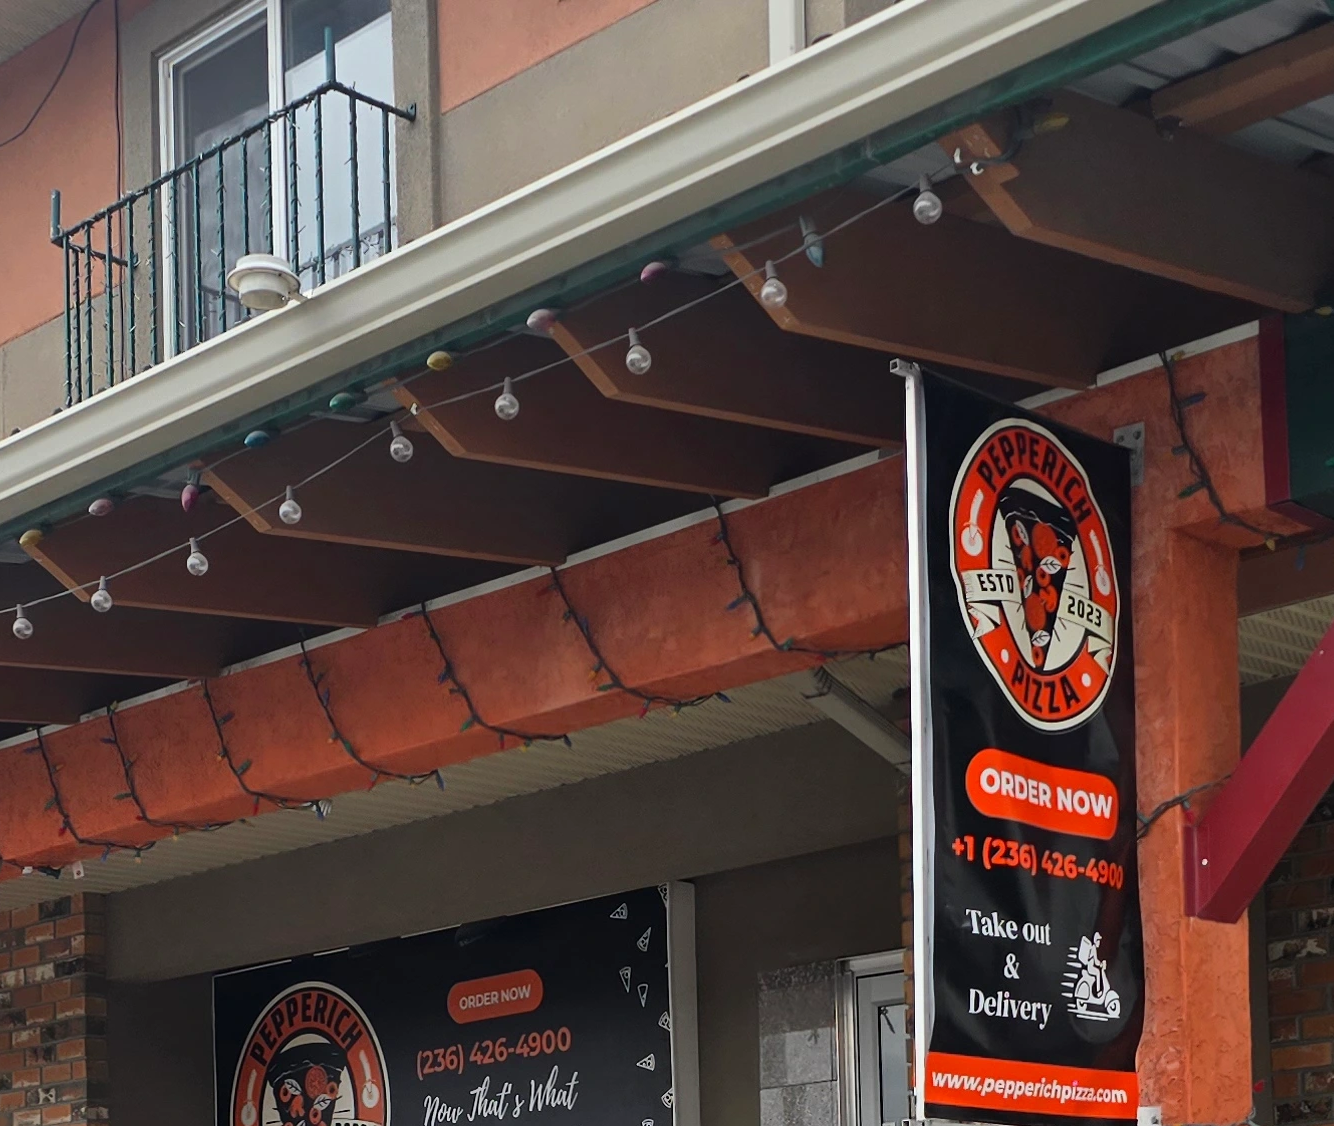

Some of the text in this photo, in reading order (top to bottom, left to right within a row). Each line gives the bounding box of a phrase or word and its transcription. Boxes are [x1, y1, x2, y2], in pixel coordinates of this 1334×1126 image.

[976, 431, 1093, 526] PEPPERICH
[977, 573, 1015, 595] ESTD
[1067, 596, 1103, 628] 2023
[1011, 660, 1081, 713] PIZZA
[979, 767, 1113, 820] ORDER NOW
[951, 835, 1124, 891] +1 (236) 426-4900
[965, 908, 1052, 945] Take out
[1003, 953, 1021, 980] &
[458, 984, 532, 1011] ORDER NOW
[968, 988, 1053, 1031] Delivery
[249, 992, 364, 1068] PEPPERICH
[417, 1026, 572, 1081] (236) 426-4900
[467, 1076, 525, 1122] That's
[528, 1065, 580, 1113] What
[931, 1071, 1128, 1105] www.pepperichpizza.com
